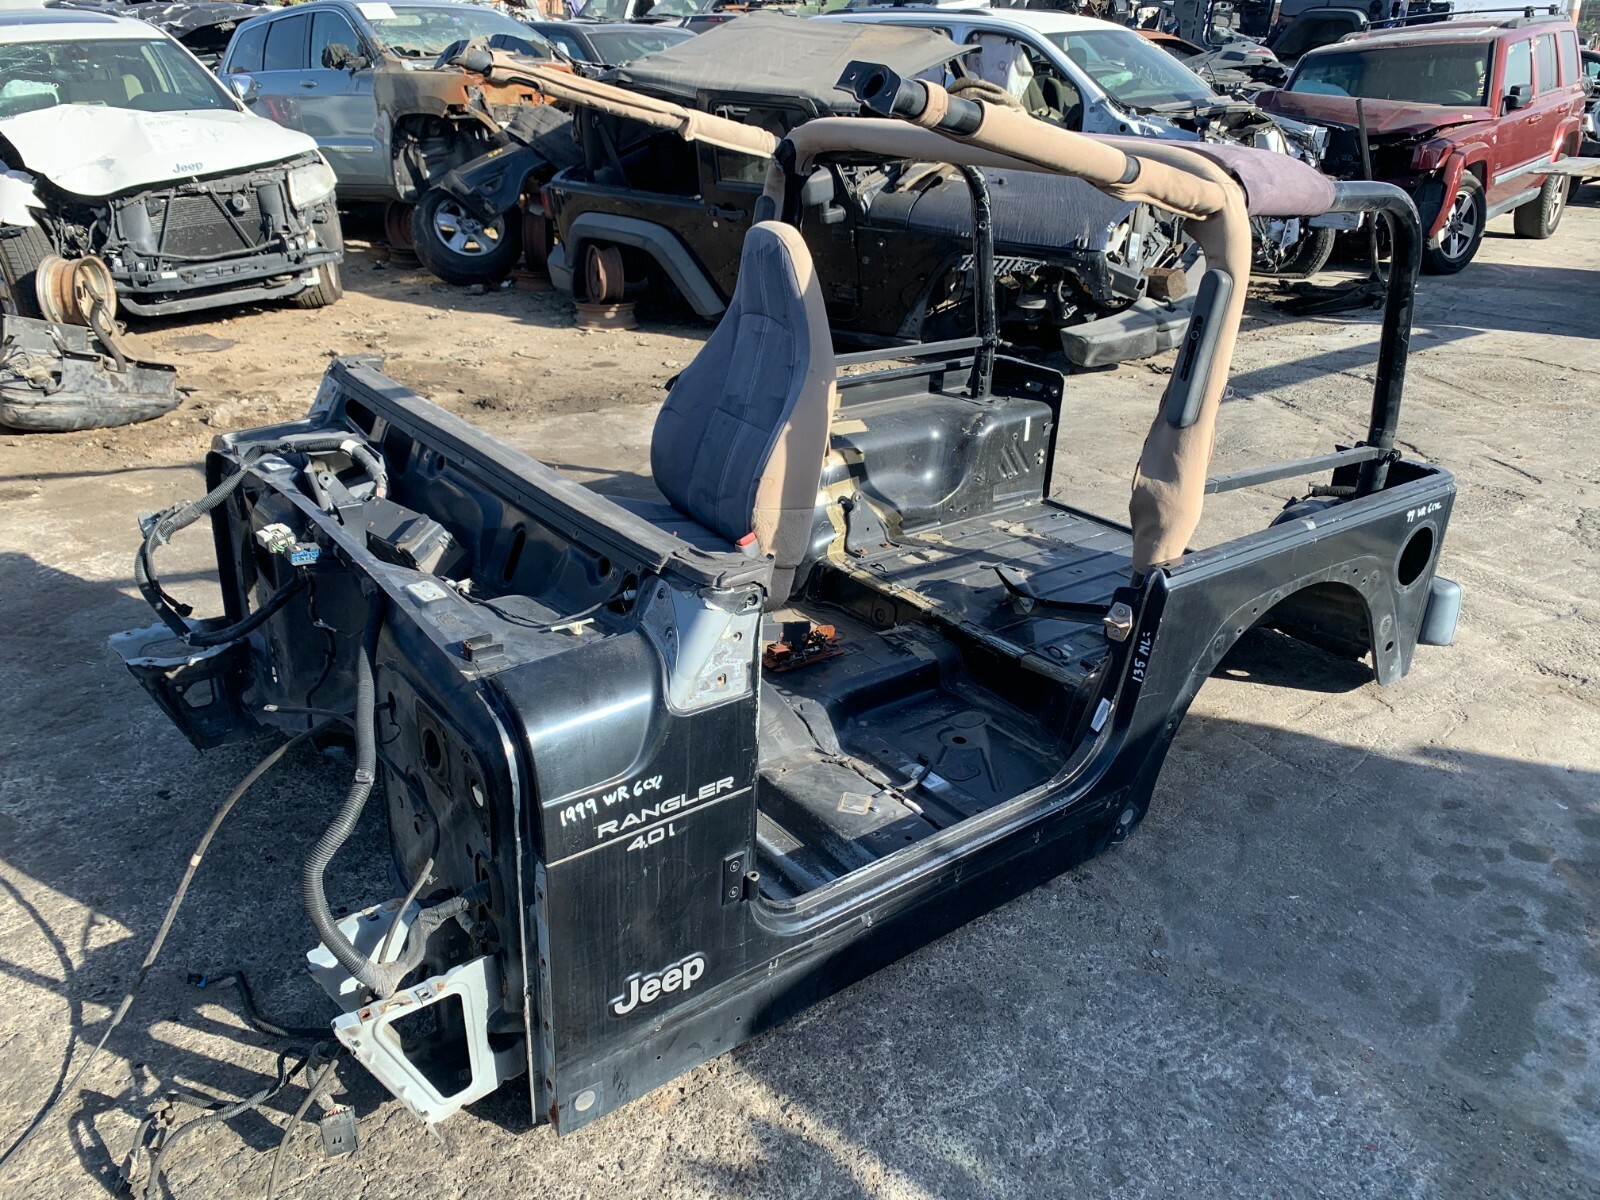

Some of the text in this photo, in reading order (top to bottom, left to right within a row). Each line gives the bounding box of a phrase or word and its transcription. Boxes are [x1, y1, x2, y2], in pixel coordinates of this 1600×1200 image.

[172, 162, 203, 174] Jeep
[1132, 657, 1146, 683] 135
[560, 798, 598, 827] 1999
[602, 785, 630, 806] WR
[597, 776, 735, 839] RANGLER
[614, 957, 705, 1015] Jeep
